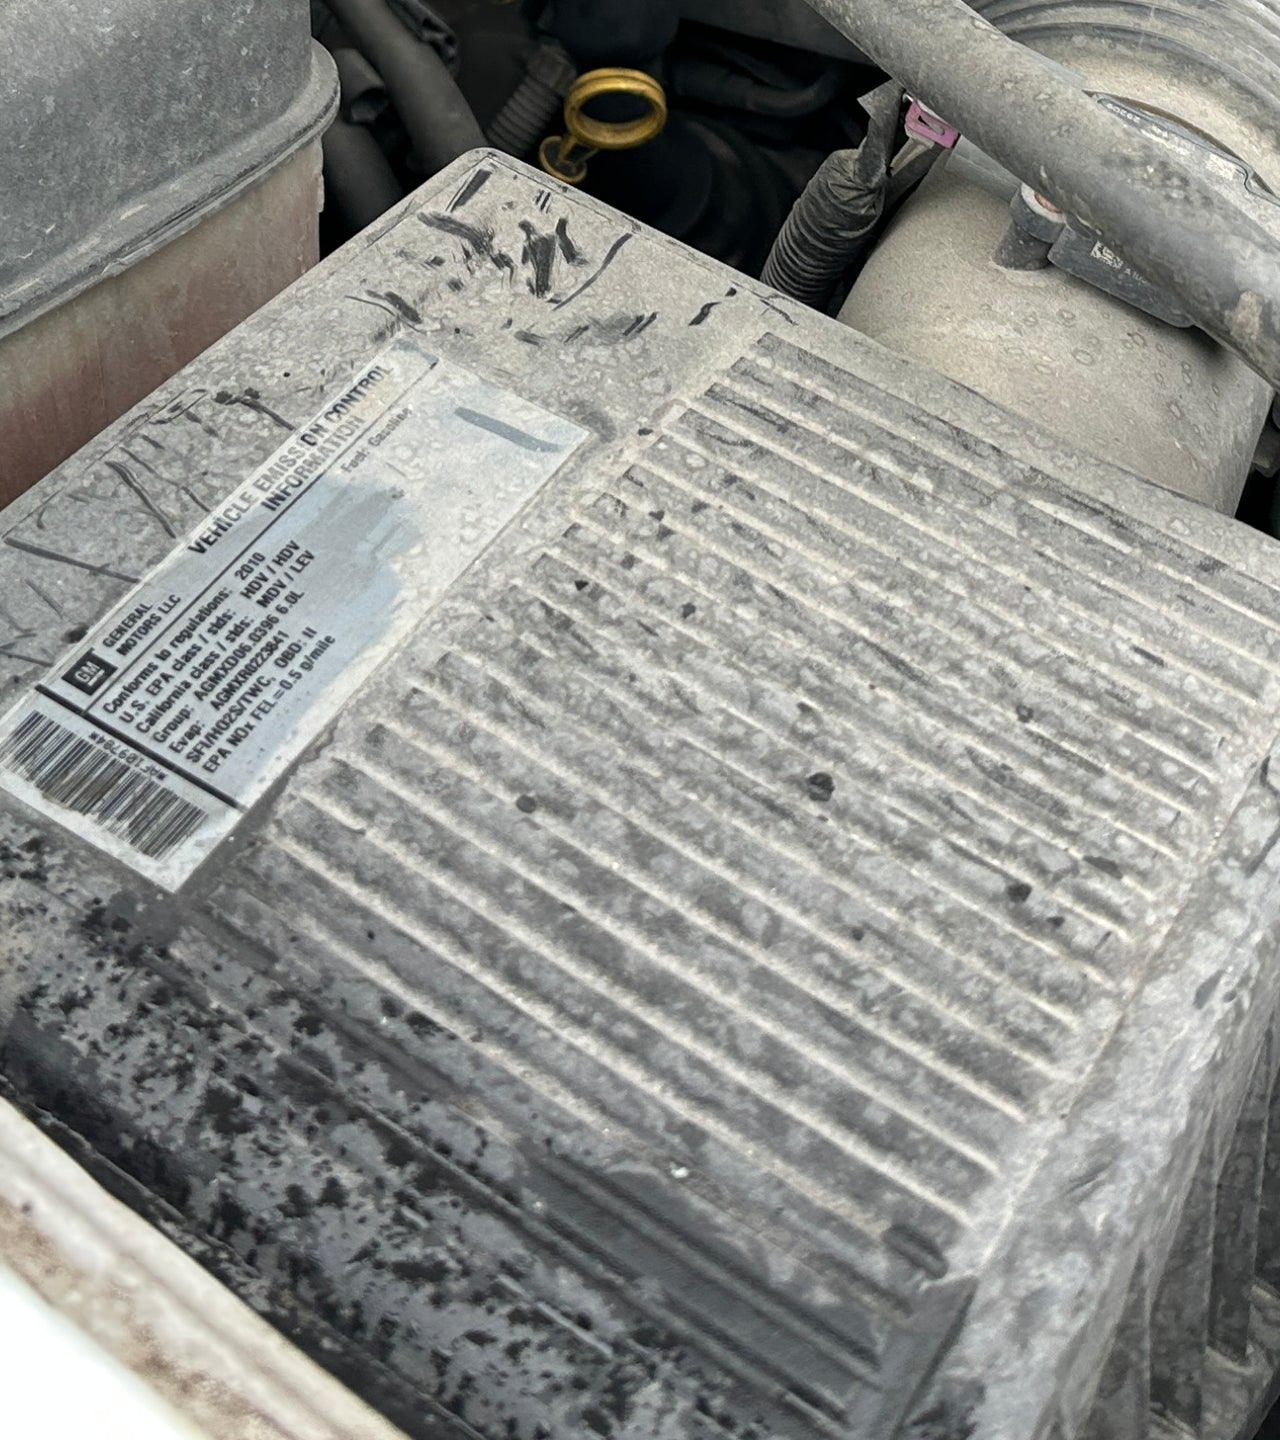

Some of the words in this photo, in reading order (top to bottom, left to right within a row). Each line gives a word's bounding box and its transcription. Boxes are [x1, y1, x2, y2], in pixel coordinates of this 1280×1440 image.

[186, 490, 260, 556] VEHICLE
[251, 421, 331, 493] EMISSION
[321, 360, 394, 425] CONTROL
[258, 412, 367, 512] INFORMATION
[365, 405, 414, 448] Gasoline
[71, 658, 102, 684] GM
[99, 600, 154, 649] GENERAL
[100, 659, 161, 715] Conforms
[153, 646, 173, 662] to
[165, 584, 237, 650] regulations:
[232, 550, 267, 581] 2010
[113, 611, 164, 657] MOTORS
[156, 592, 183, 615] LLC
[117, 695, 151, 724] U.S.
[144, 670, 175, 697] EPA
[168, 641, 204, 673] class
[204, 606, 238, 636] stds:
[238, 571, 271, 600] HDV
[270, 539, 304, 567] HDV
[133, 677, 194, 735] California
[185, 648, 222, 680] class
[221, 613, 255, 643] stds:
[254, 578, 289, 609] MDV
[287, 548, 317, 574] LEV
[150, 702, 197, 745] Group:
[273, 587, 305, 615] 6.0L
[272, 637, 308, 669] OBD:
[167, 718, 208, 755] Evap:
[200, 745, 232, 774] EPA
[225, 719, 256, 747] NOx
[296, 633, 339, 672] g/mile
